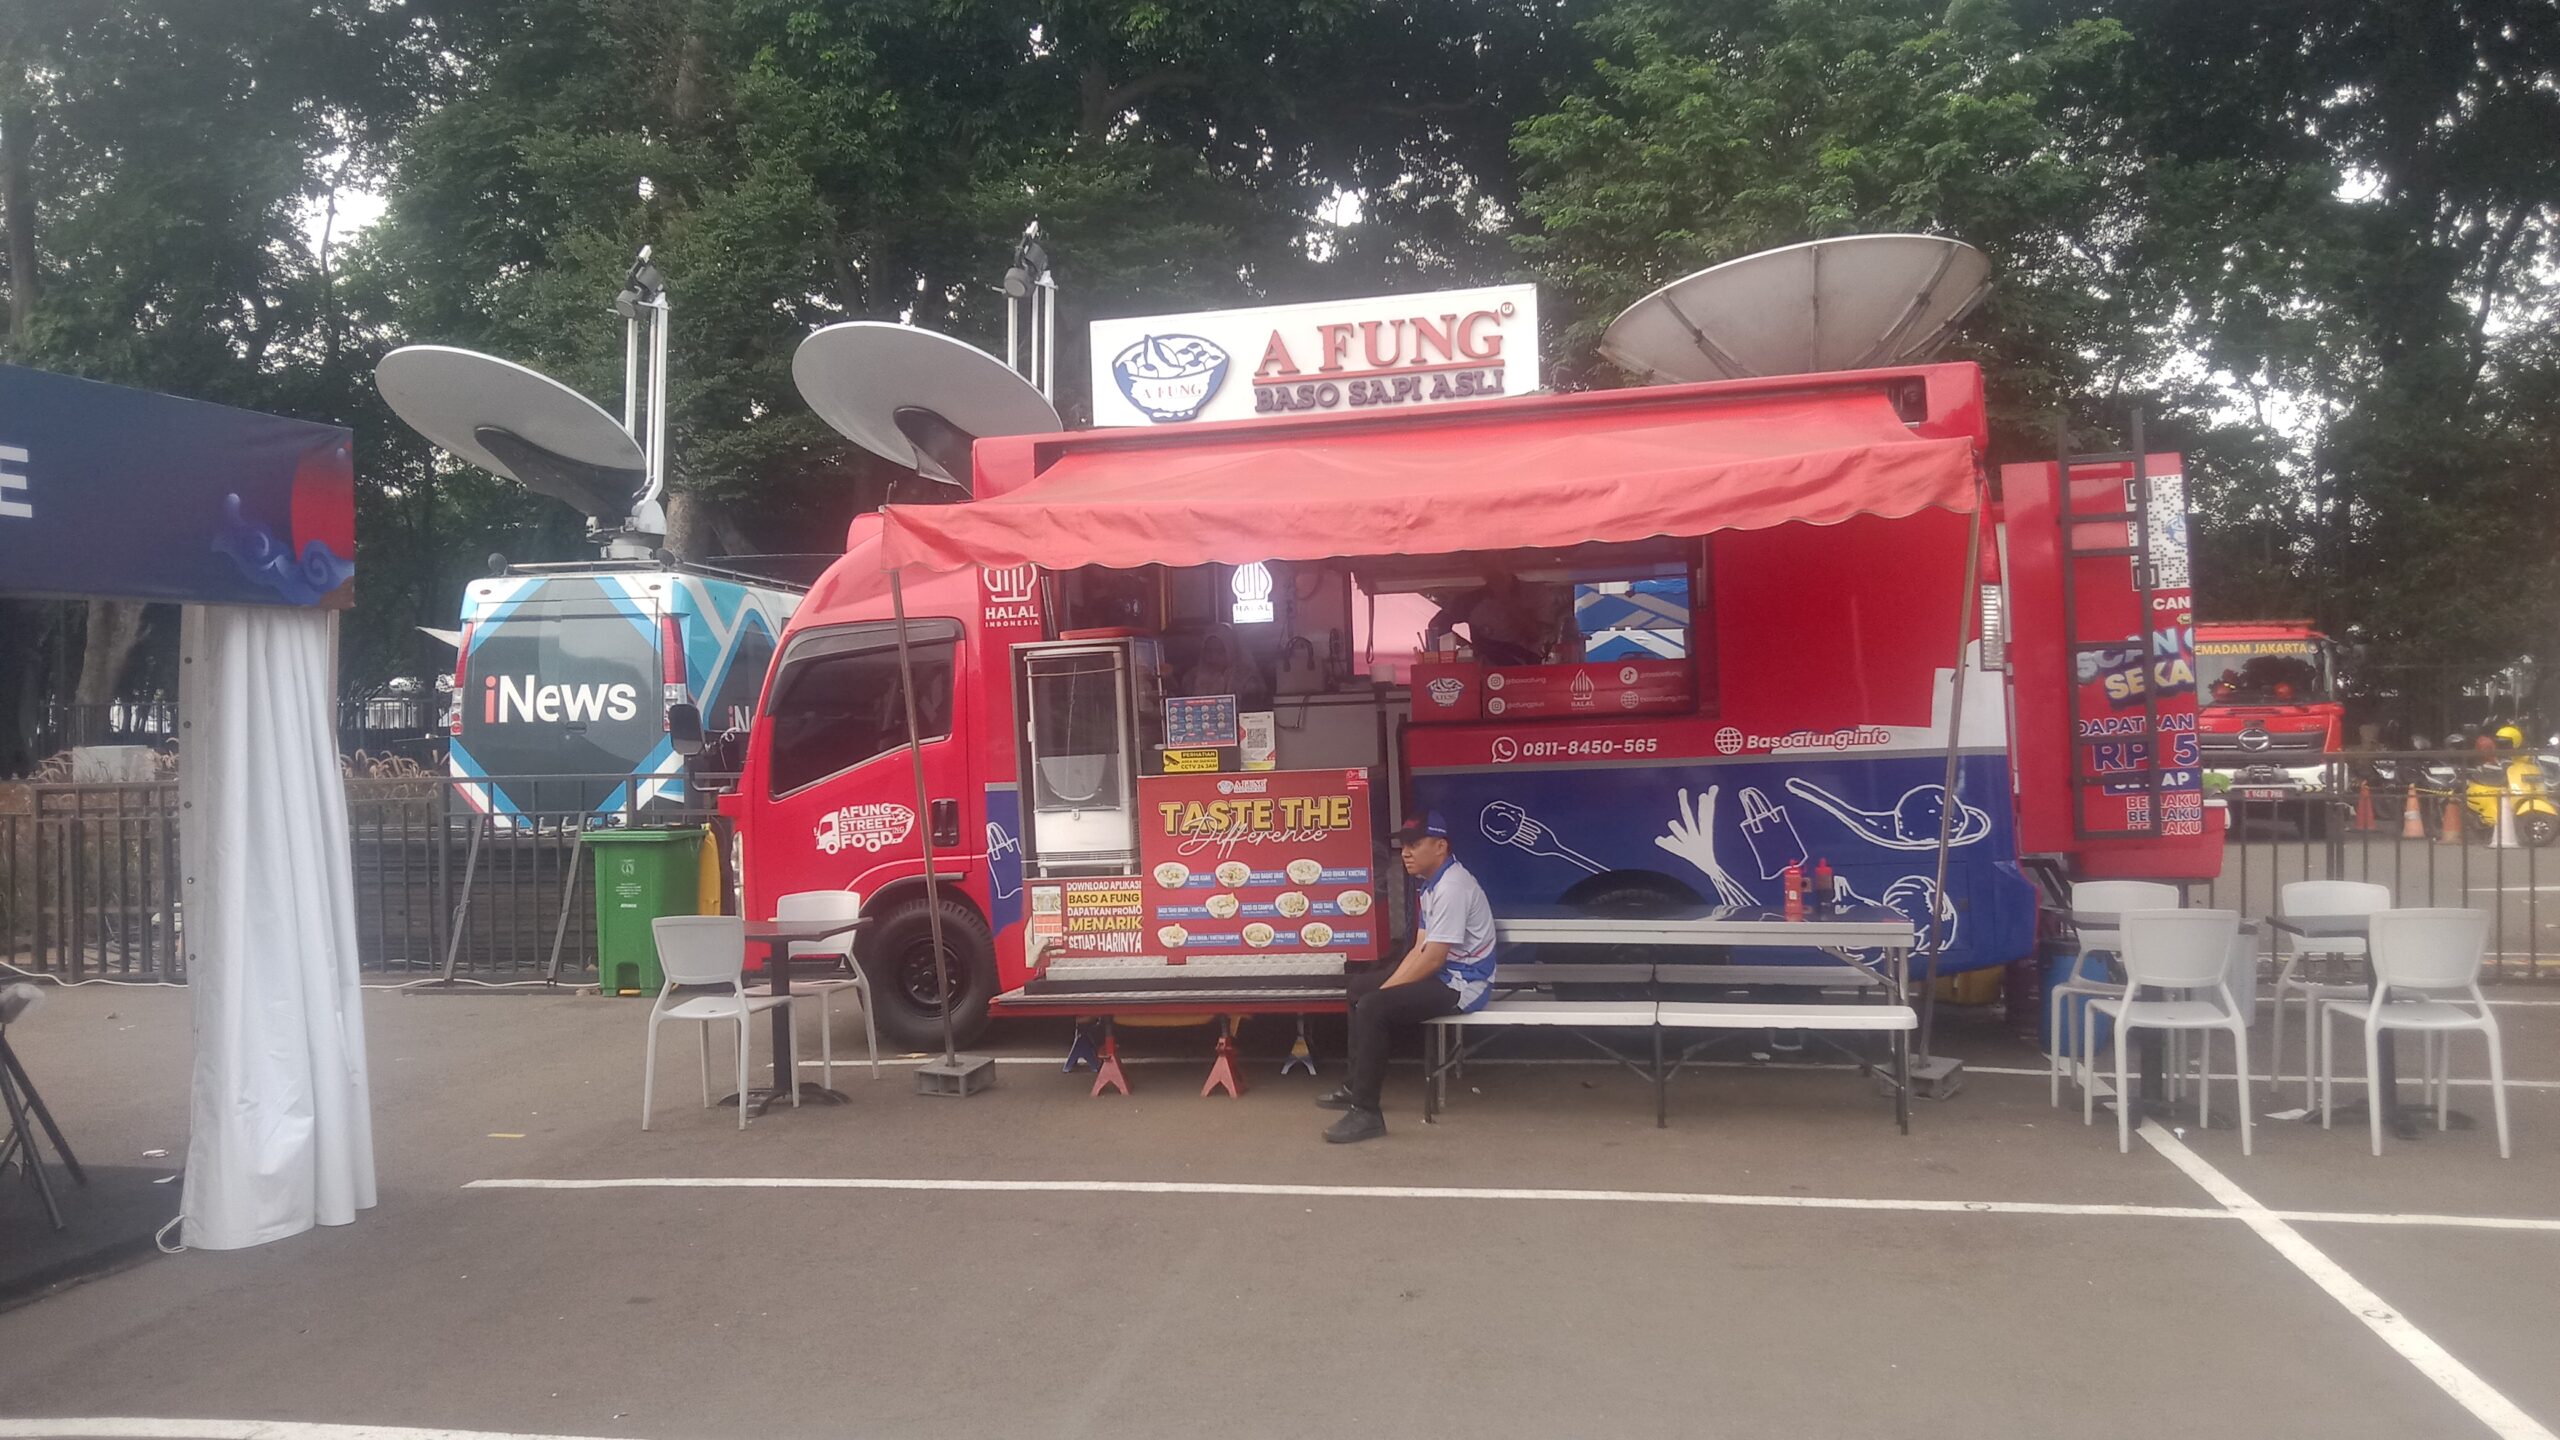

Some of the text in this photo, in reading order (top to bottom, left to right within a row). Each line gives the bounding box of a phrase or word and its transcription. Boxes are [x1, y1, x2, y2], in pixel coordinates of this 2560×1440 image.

[1254, 309, 1504, 377] A FUNG
[1254, 369, 1505, 413] BASO SAPI ASLI
[985, 605, 1039, 619] HALAL
[985, 619, 1040, 628] INDONESIA
[2254, 642, 2308, 654] JAKARTA
[484, 674, 637, 724] iNews
[1522, 738, 1658, 757] 0811-8450-565
[2126, 793, 2201, 810] BELAKU
[839, 803, 891, 819] AFUNG
[1159, 796, 1352, 836] TASTE THE
[2127, 807, 2201, 823] BELAKU
[839, 817, 893, 832] STREET
[1177, 811, 1328, 860] Difference
[1067, 880, 1142, 891] DOWNLOAD APLIKASI
[1069, 893, 1140, 904] BASO A FUNG
[1067, 905, 1142, 916] DAPATKAN PROMO
[1069, 916, 1143, 932] MENARIK
[1069, 932, 1142, 953] SETIAP HARINYA
